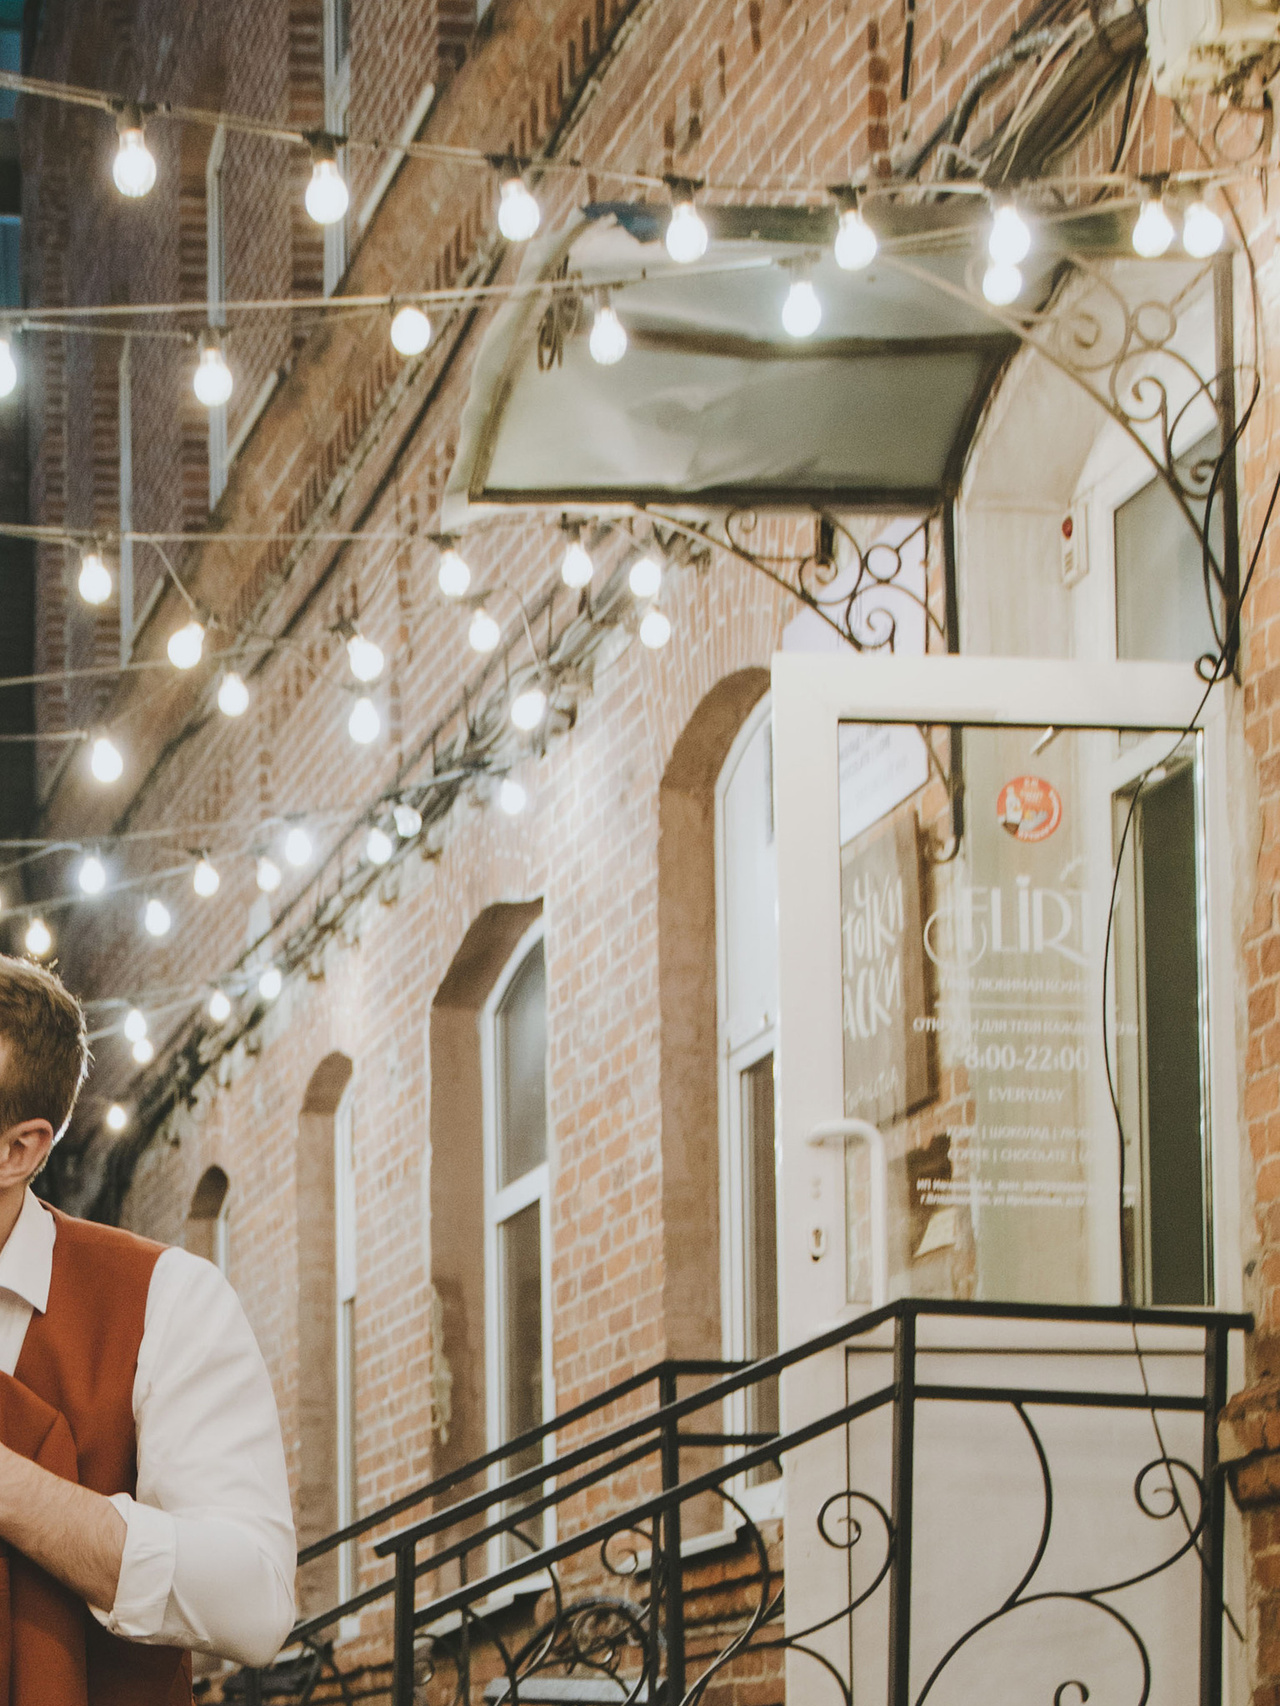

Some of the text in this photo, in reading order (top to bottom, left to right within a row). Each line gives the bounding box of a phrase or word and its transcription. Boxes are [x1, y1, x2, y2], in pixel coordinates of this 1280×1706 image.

[988, 1086, 1066, 1103] EVERYDAY
[989, 1126, 1050, 1140] ШОКОЛАД
[1000, 1149, 1066, 1163] CHOCOLATE
